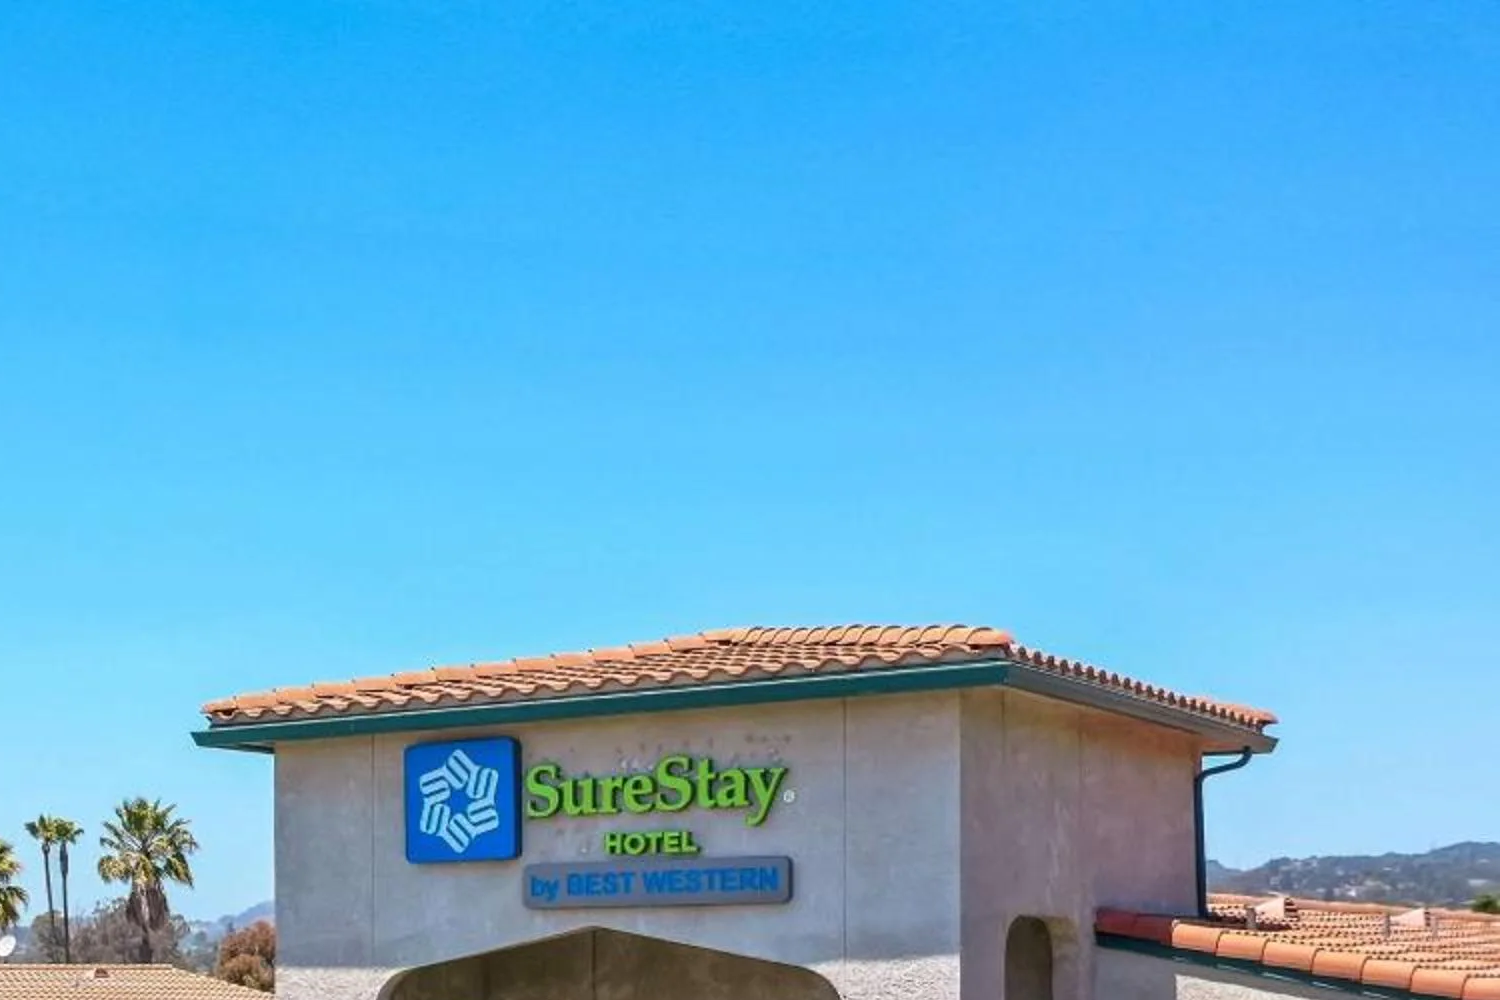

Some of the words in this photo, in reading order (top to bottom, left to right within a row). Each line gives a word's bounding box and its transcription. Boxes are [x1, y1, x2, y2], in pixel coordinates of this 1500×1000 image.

[604, 831, 698, 855] HOTEL
[530, 876, 559, 901] by
[567, 872, 635, 896] BEST
[642, 867, 779, 894] WESTERN
